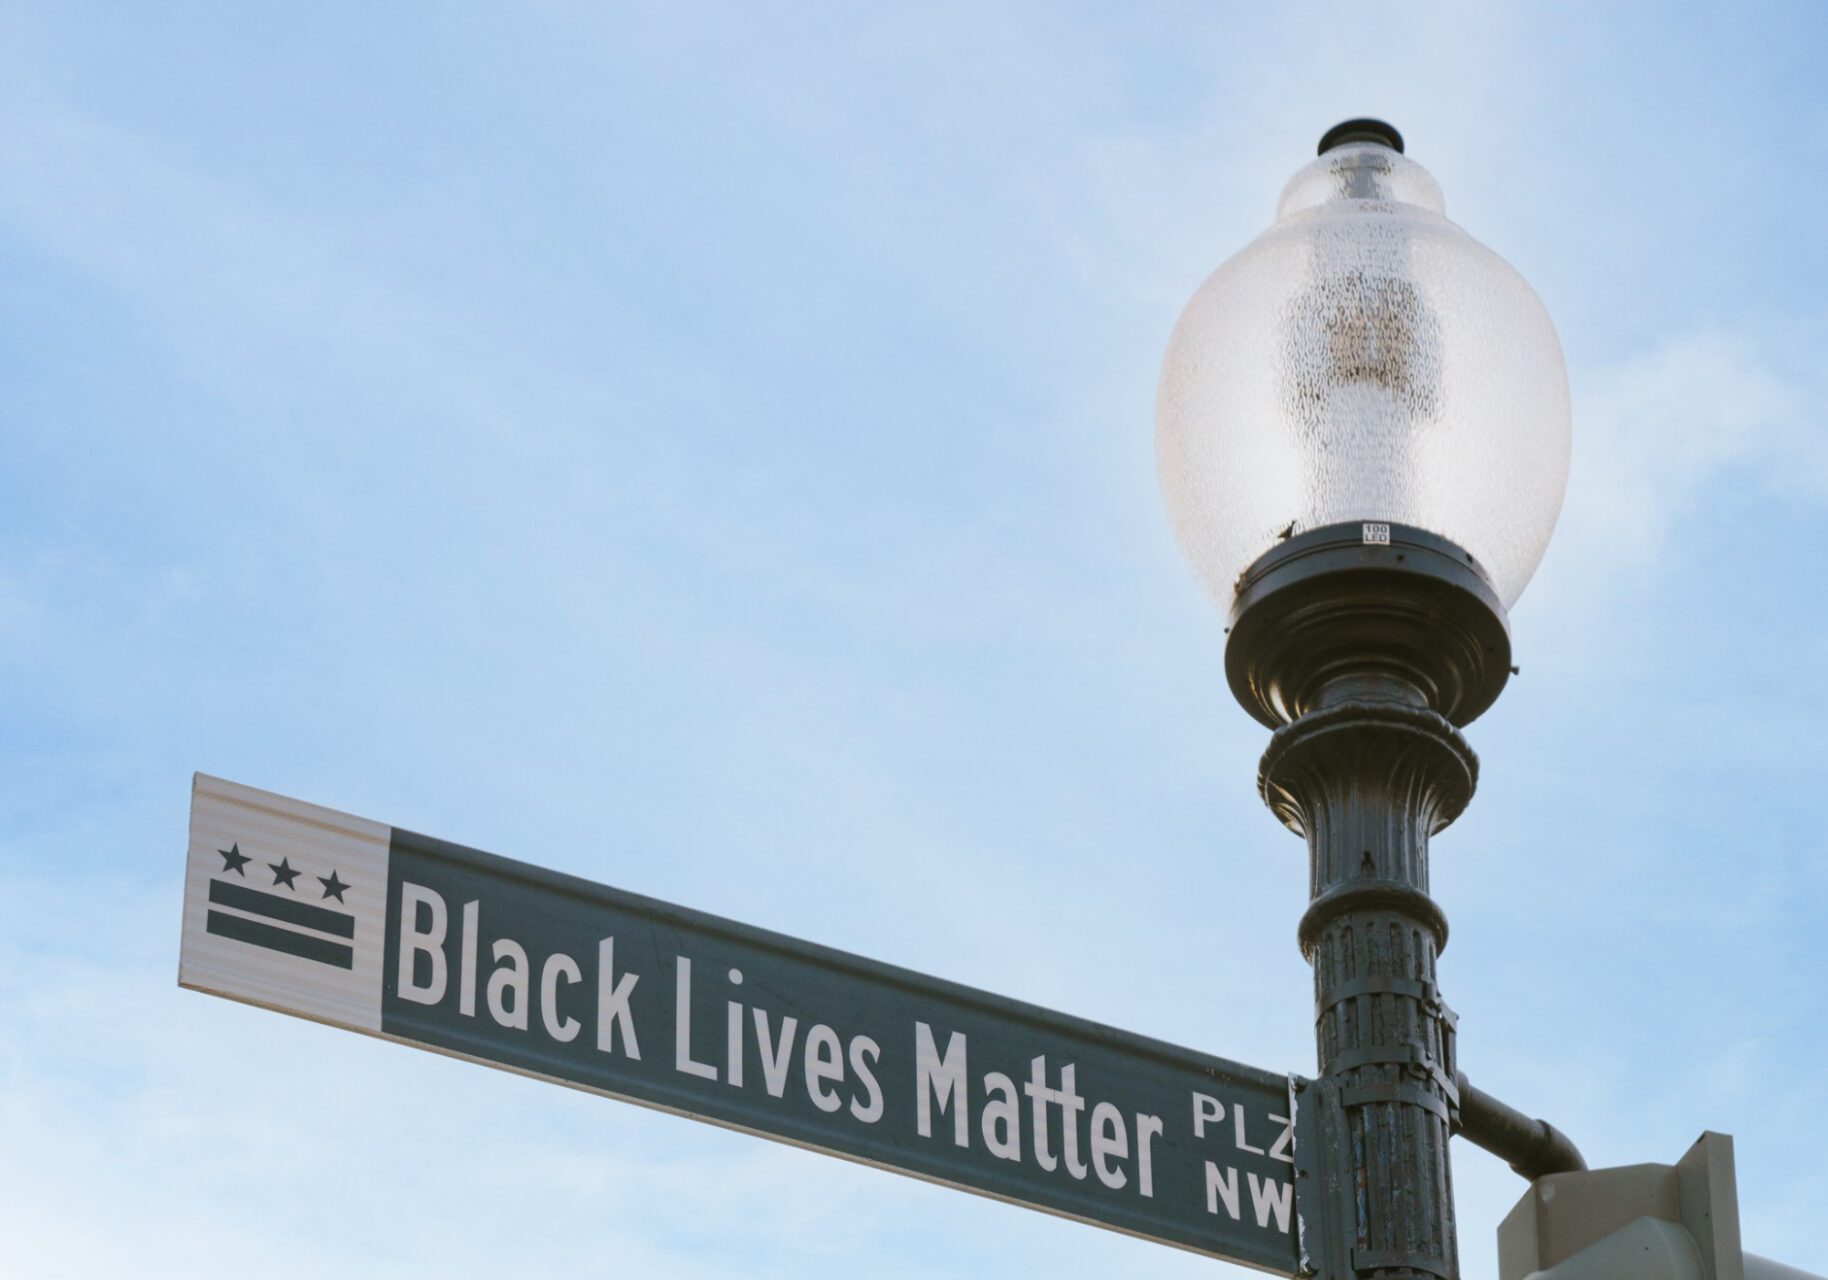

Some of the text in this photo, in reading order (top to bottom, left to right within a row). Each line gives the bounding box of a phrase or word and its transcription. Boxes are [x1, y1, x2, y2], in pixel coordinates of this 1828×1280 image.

[1365, 533, 1388, 542] LED
[1366, 525, 1388, 533] 100
[397, 881, 1163, 1198] Black Lives Matter
[1192, 1091, 1294, 1163] PLZ
[1205, 1160, 1293, 1234] NW
